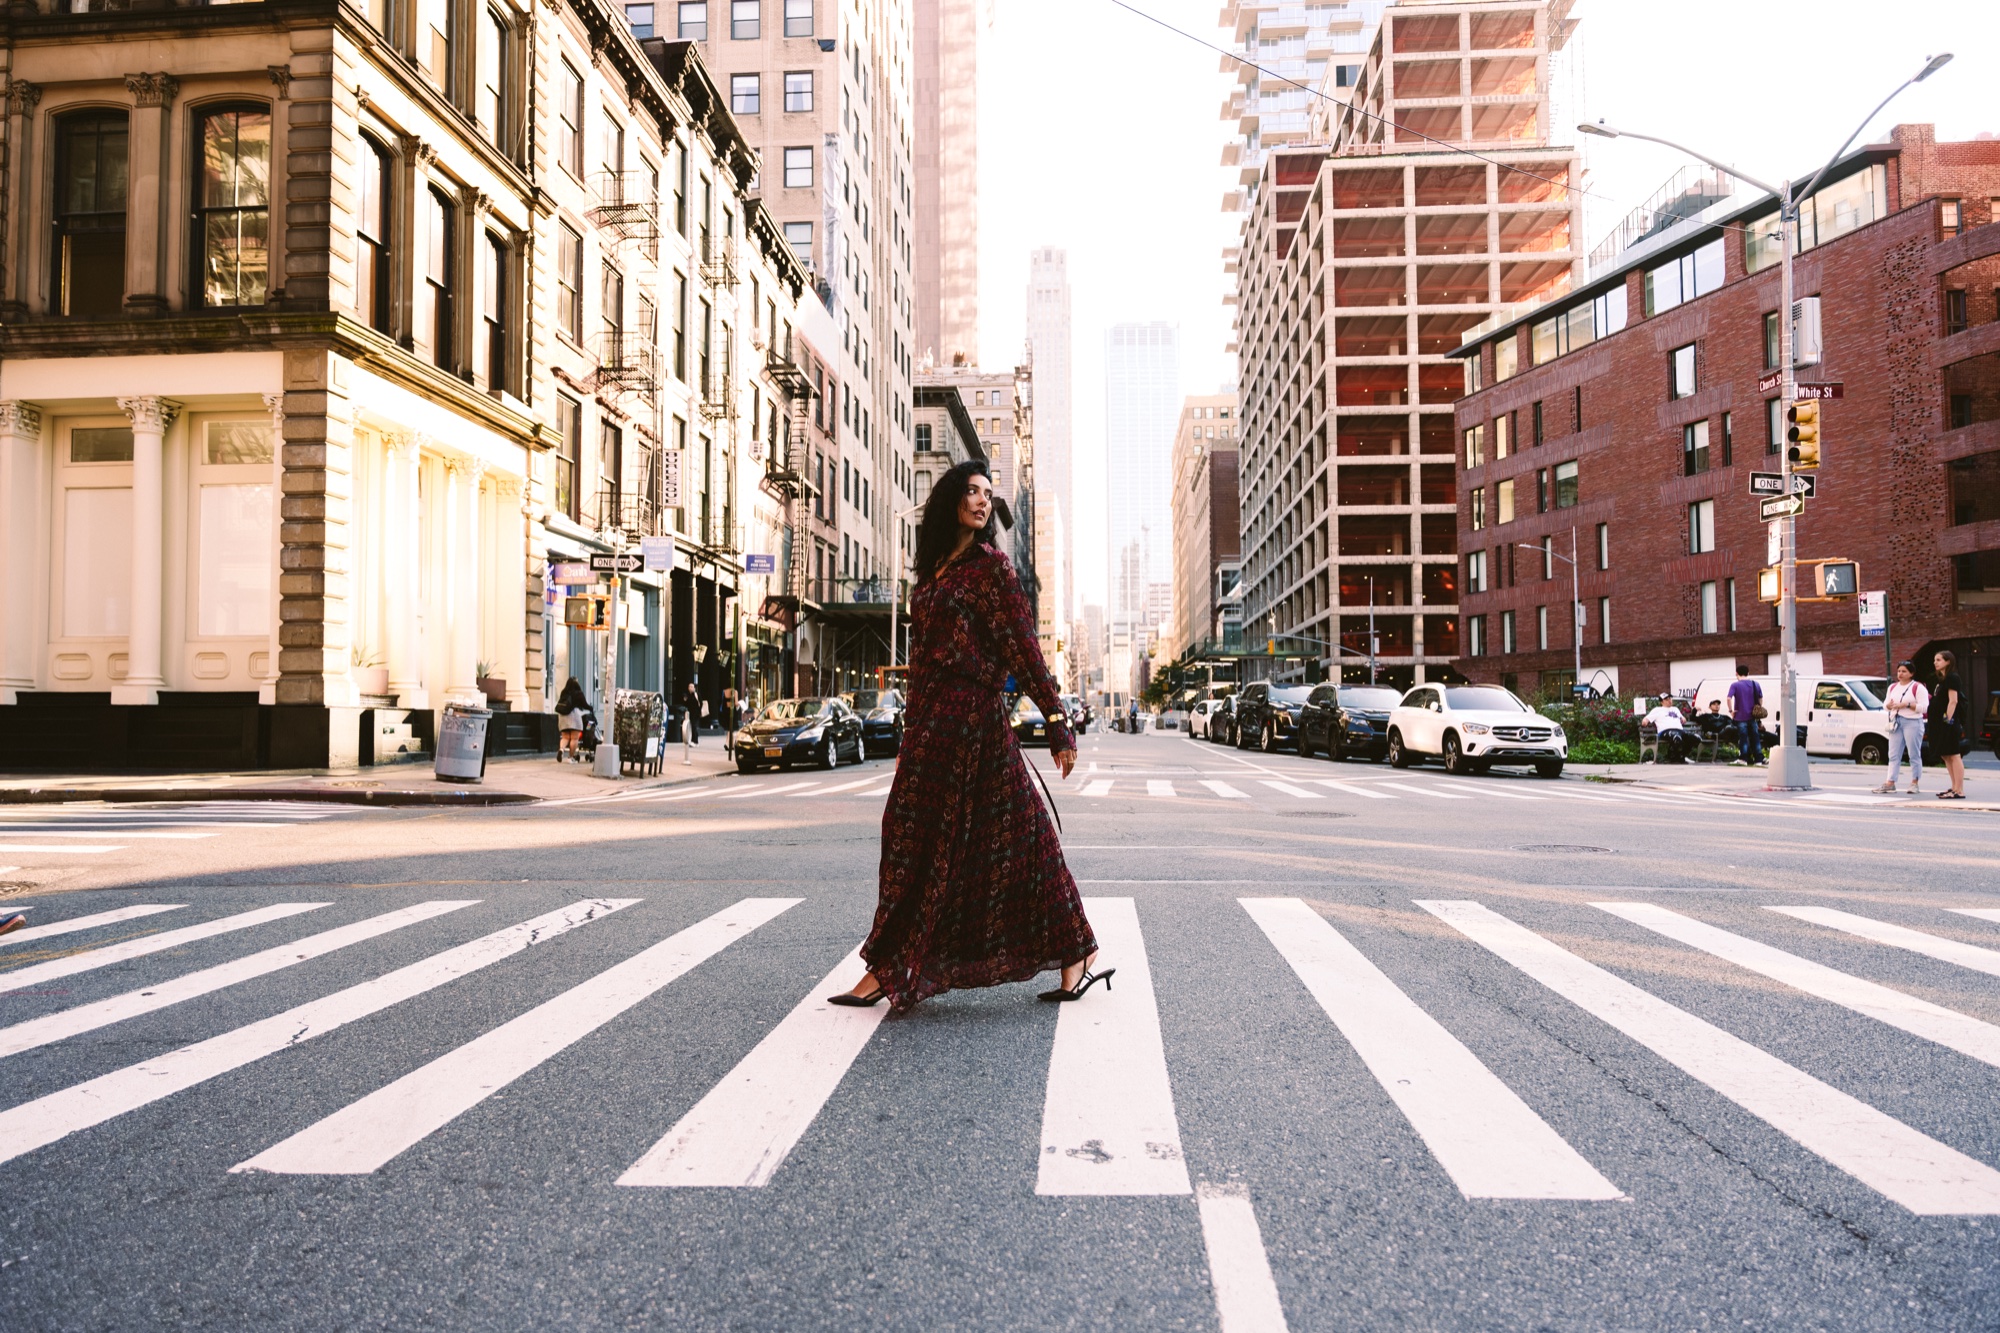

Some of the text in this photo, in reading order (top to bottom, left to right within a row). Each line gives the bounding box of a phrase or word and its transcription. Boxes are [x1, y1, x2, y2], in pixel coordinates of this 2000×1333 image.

[1759, 376, 1776, 392] Church
[1798, 386, 1833, 398] White St
[1759, 479, 1779, 489] ONE
[1766, 500, 1798, 513] ONE WAY
[597, 559, 637, 567] ONE WAY
